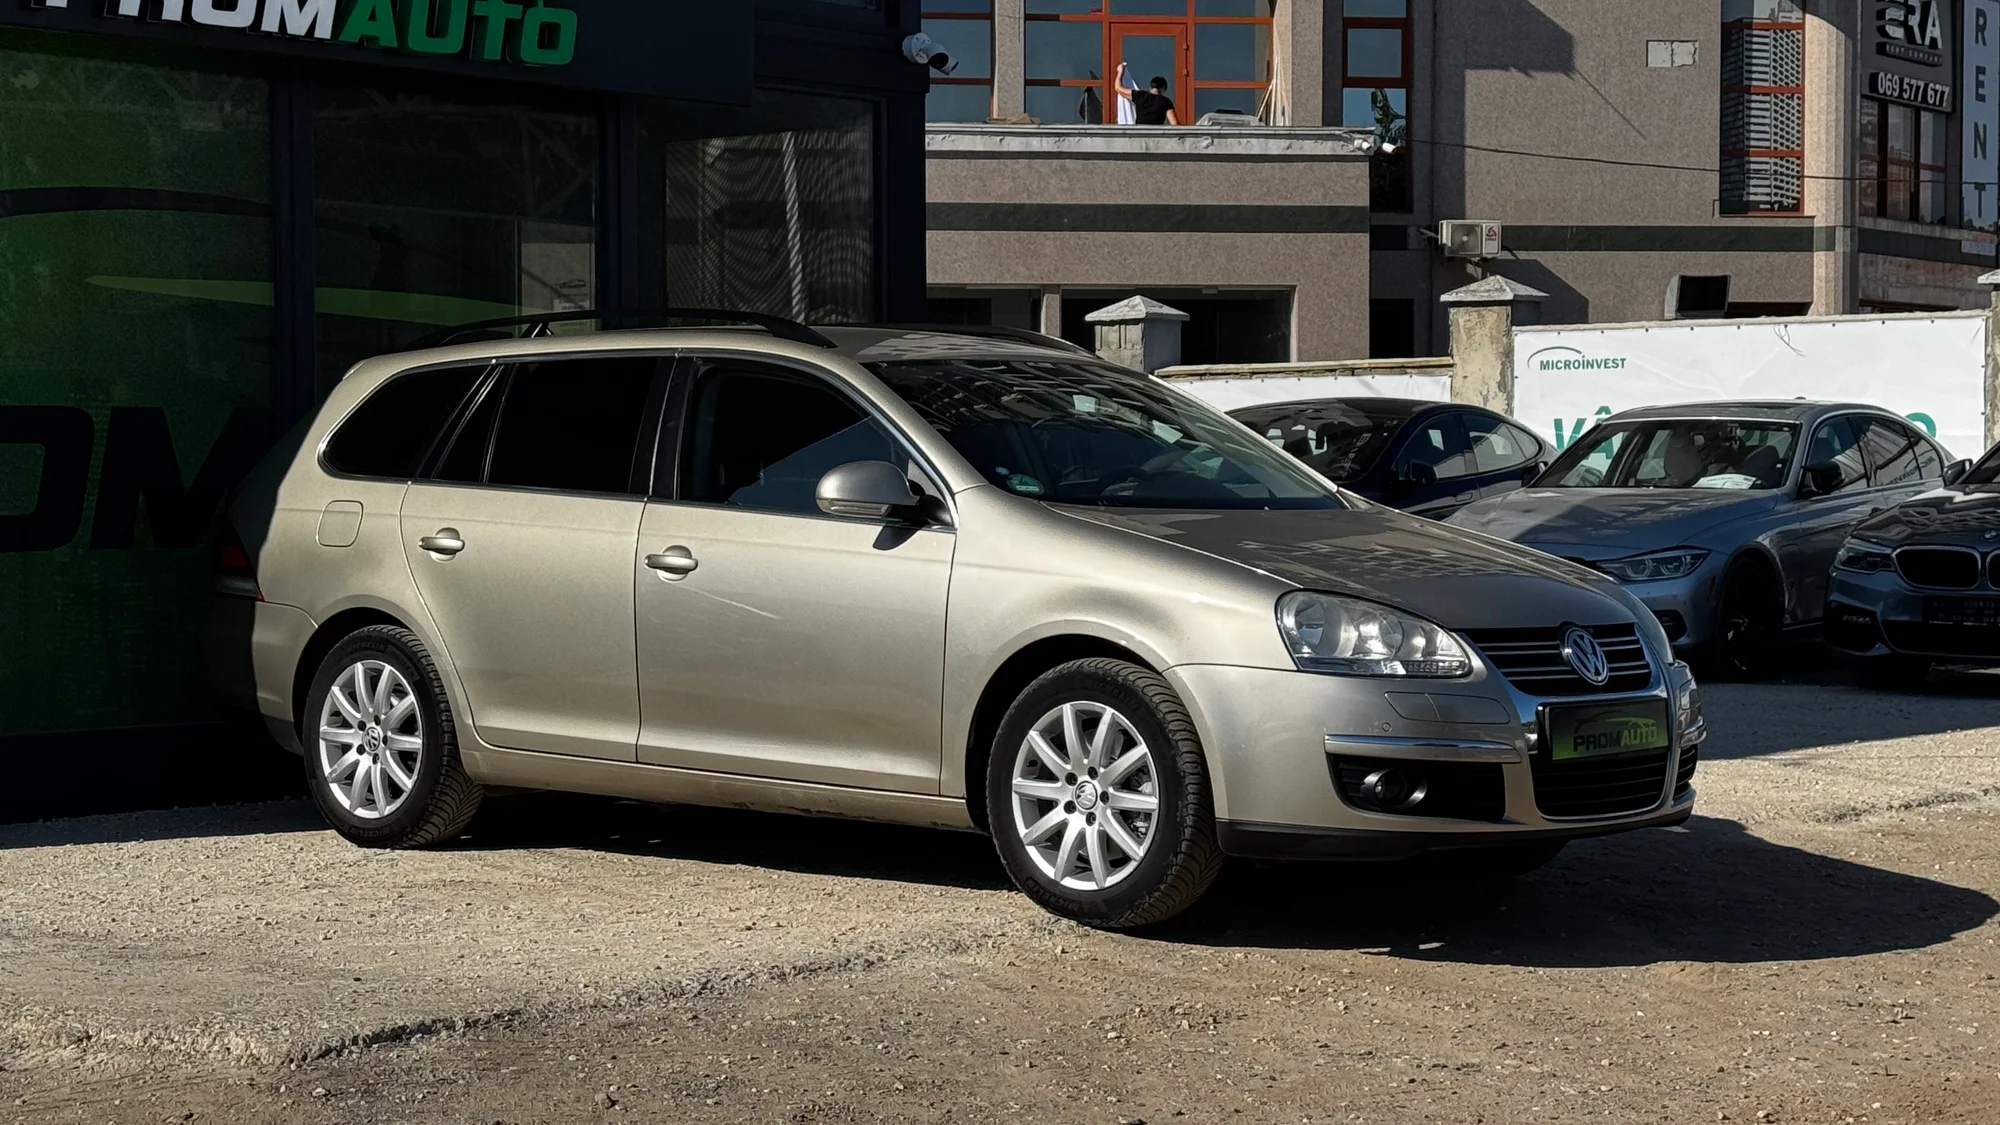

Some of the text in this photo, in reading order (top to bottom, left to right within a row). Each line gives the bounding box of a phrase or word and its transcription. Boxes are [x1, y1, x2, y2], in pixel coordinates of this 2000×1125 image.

[46, 0, 578, 65] MAUTO
[1878, 71, 1951, 107] 069 577 677
[1975, 8, 1988, 218] RENT
[1573, 726, 1658, 752] PROMAUTO
